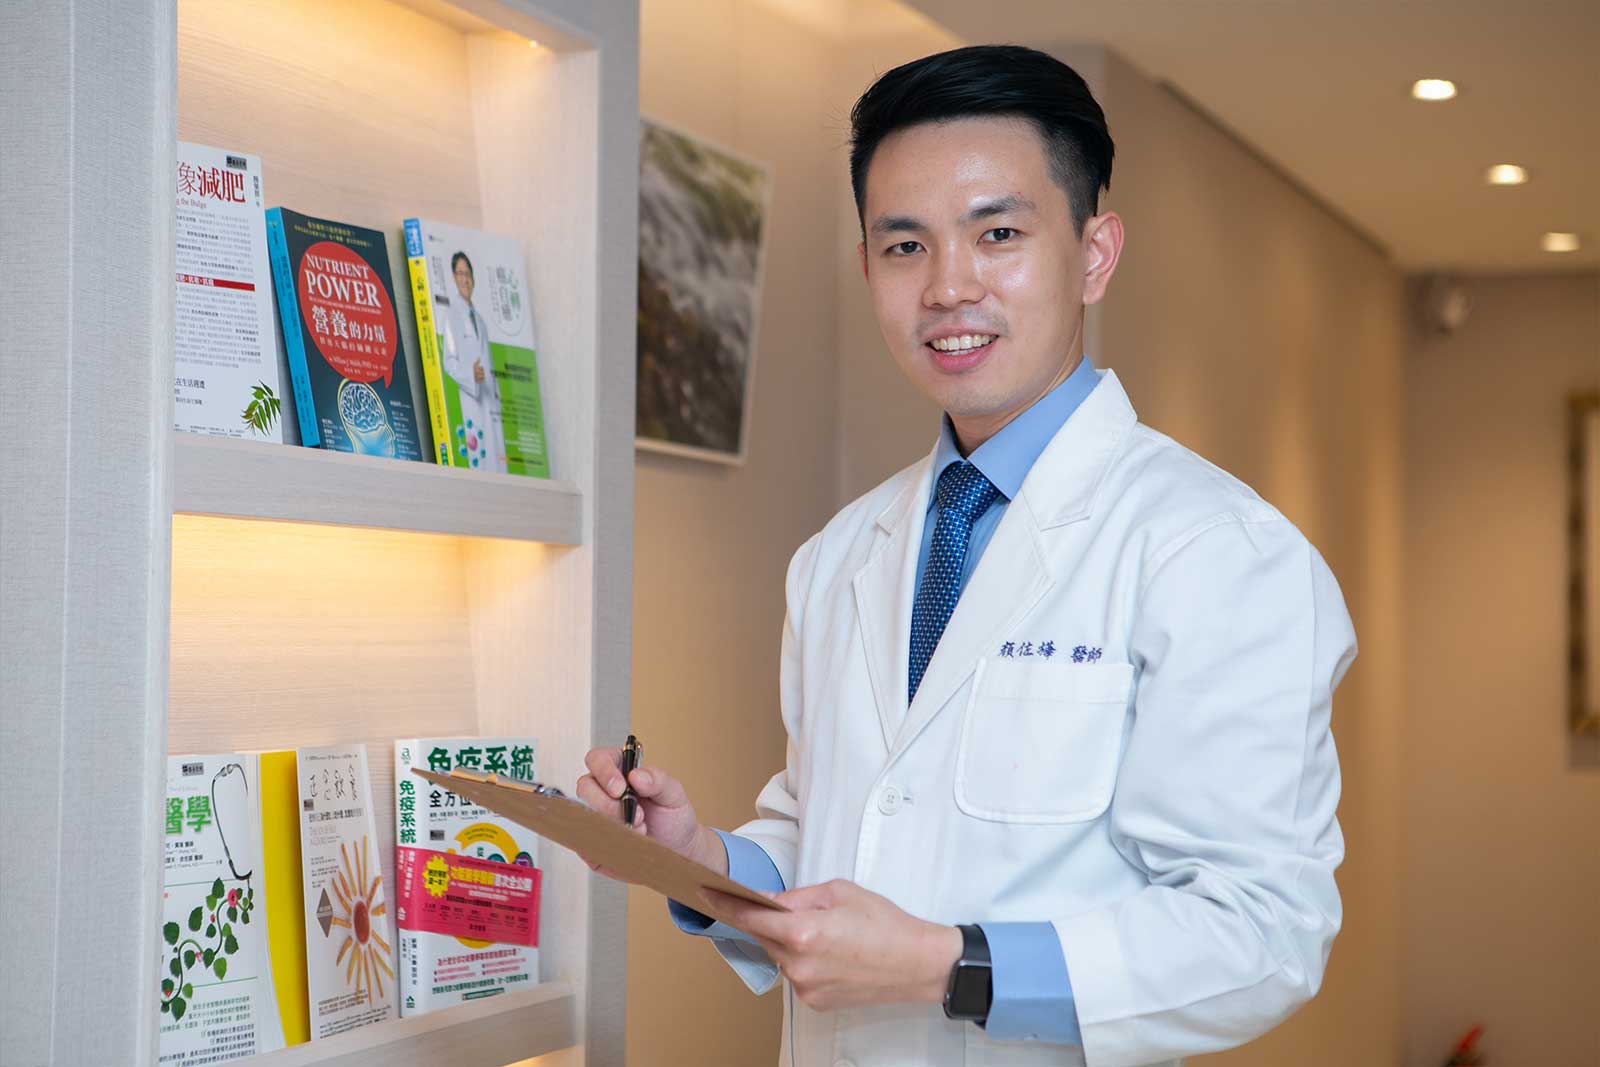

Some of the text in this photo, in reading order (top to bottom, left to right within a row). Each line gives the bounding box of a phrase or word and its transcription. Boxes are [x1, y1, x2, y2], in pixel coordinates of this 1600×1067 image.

[305, 253, 368, 279] NUTRIENT
[304, 269, 381, 308] POWER
[311, 304, 387, 344] 營養的力量
[427, 744, 535, 785] 免疫系統
[399, 780, 416, 844] 免疫系統
